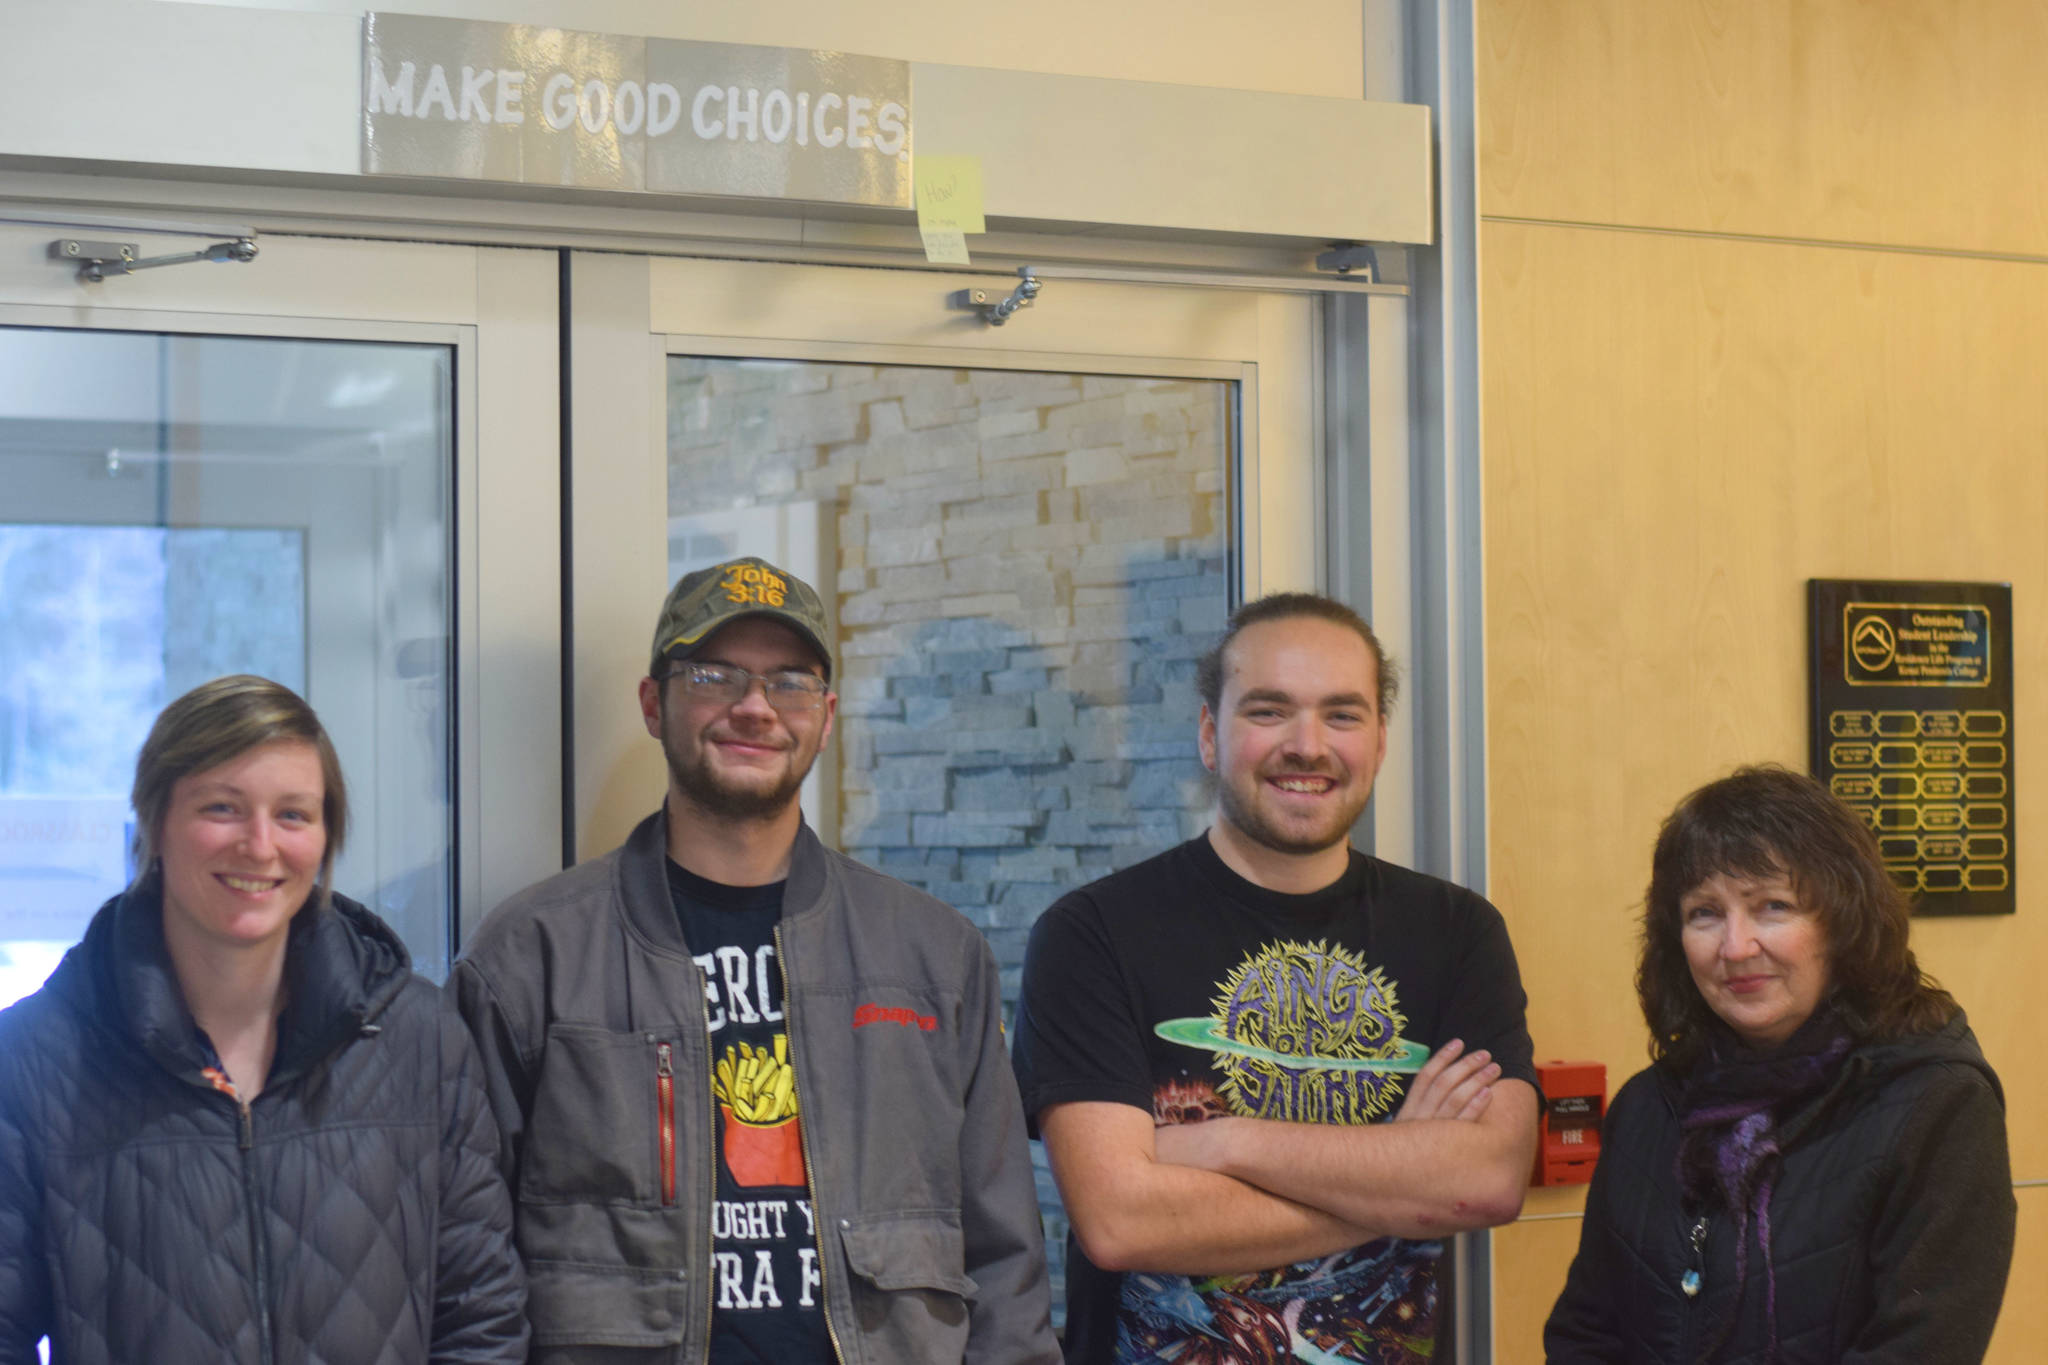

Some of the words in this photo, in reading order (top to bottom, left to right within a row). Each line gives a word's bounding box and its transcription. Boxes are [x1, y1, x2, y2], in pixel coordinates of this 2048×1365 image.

[367, 56, 526, 124] MAKE
[542, 72, 682, 137] GOOD
[721, 564, 788, 594] John
[726, 584, 785, 609] 3:16
[1561, 1128, 1584, 1145] FIRE
[710, 1250, 783, 1309] RA
